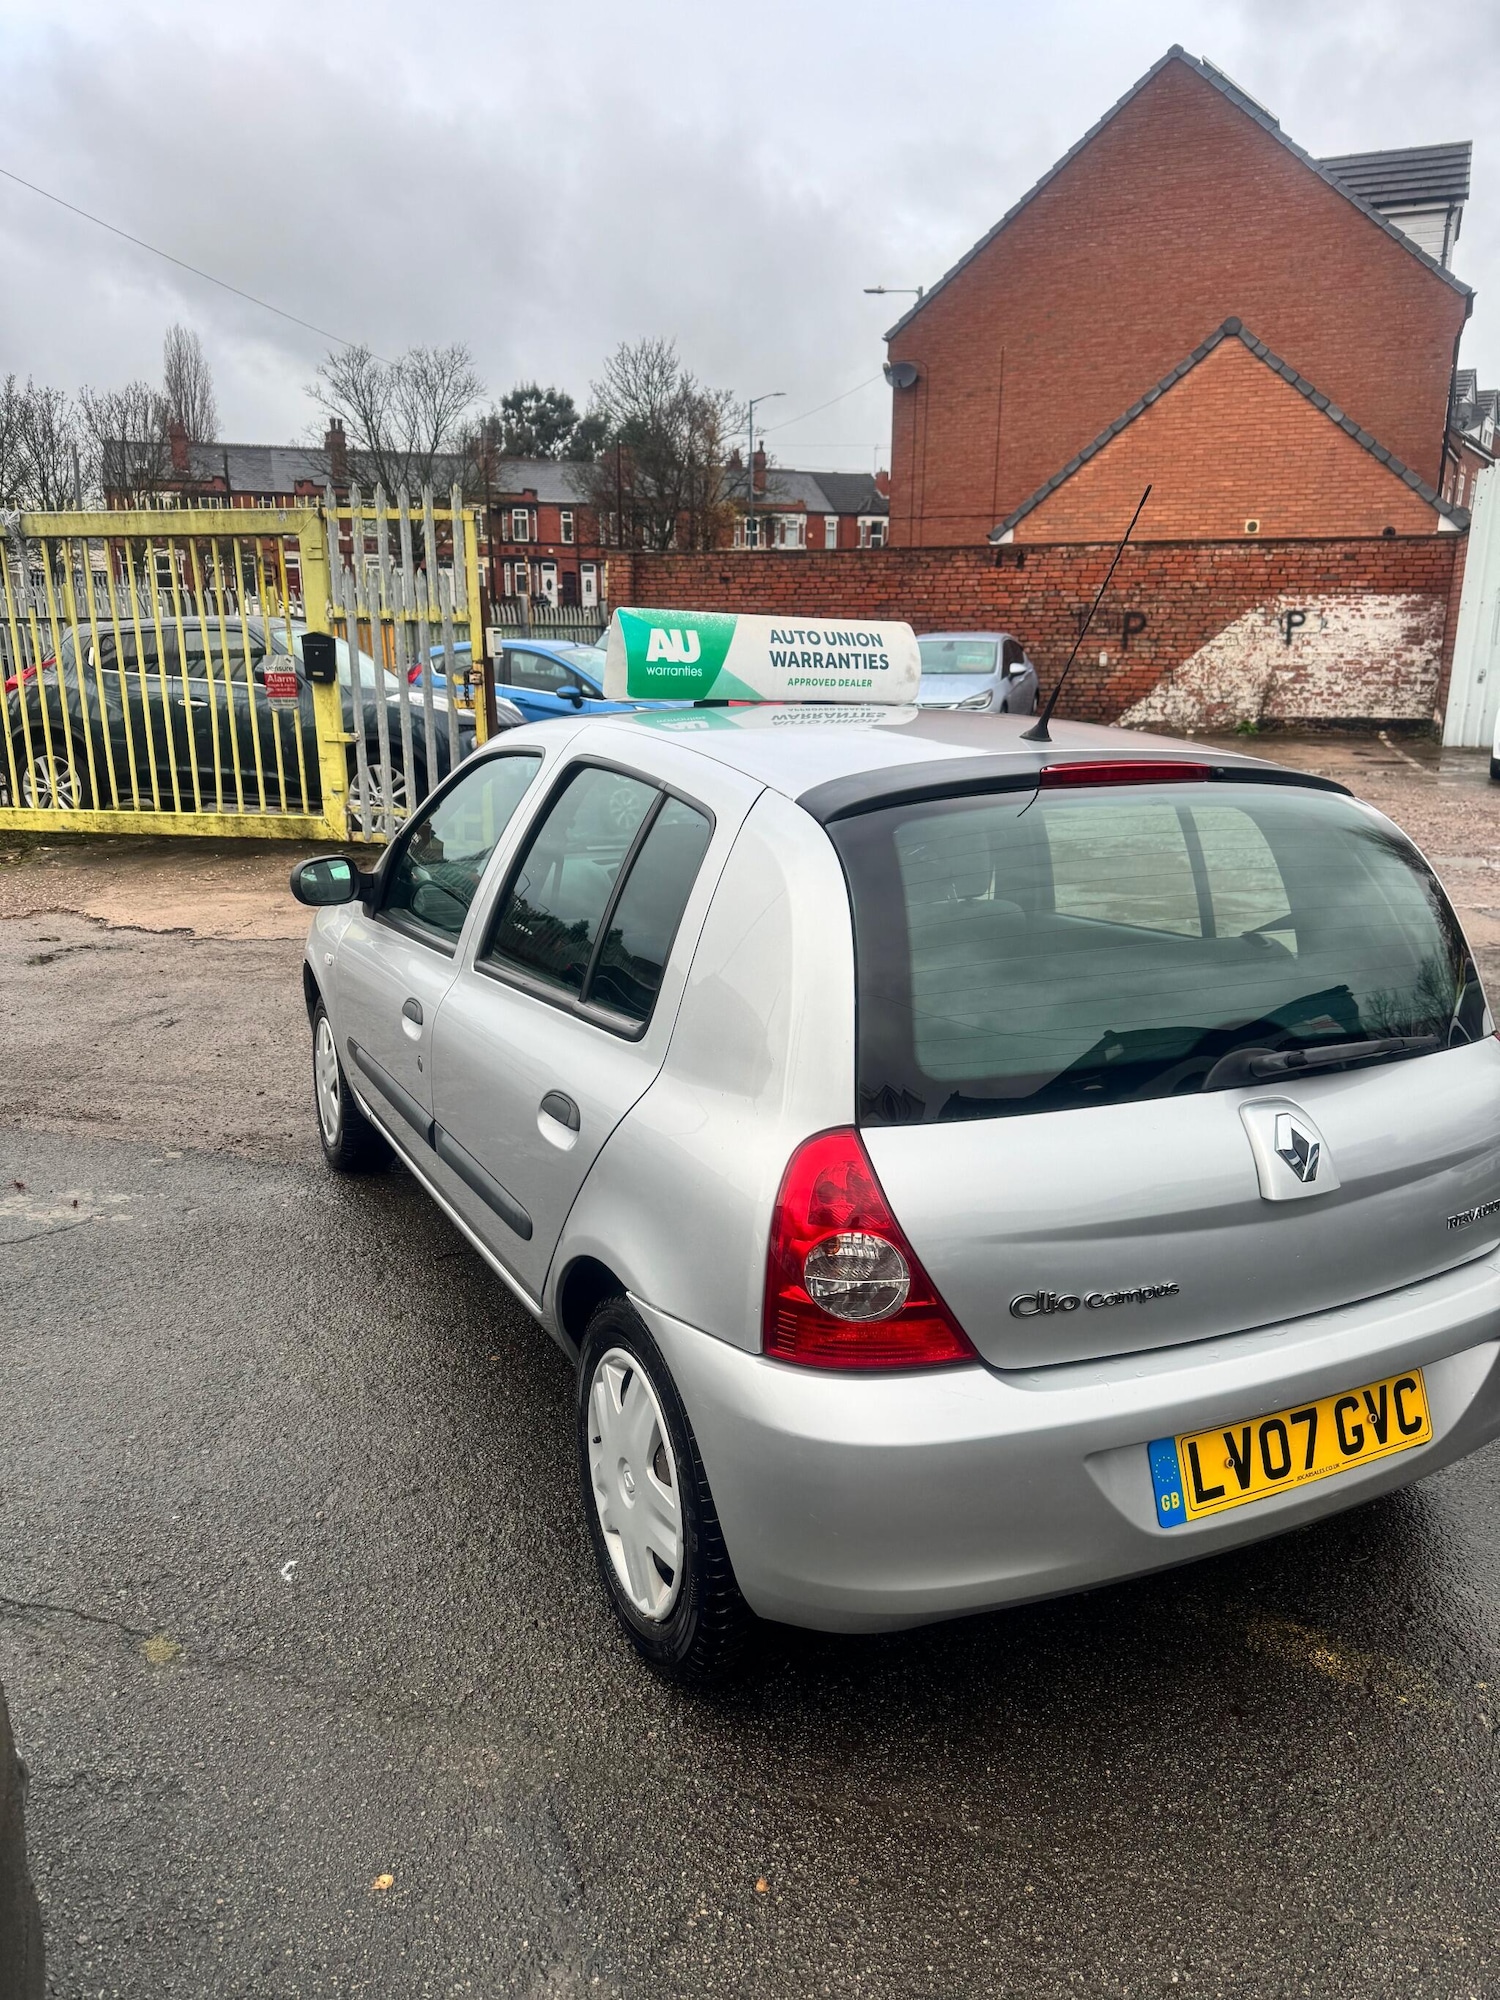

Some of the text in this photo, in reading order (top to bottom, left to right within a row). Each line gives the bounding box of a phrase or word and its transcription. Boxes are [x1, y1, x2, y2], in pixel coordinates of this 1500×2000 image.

[1285, 610, 1306, 646] P
[646, 628, 700, 663] AU
[769, 629, 884, 648] AUTO UNION
[769, 650, 890, 670] WARRANTIES
[267, 674, 295, 683] Alarm
[646, 664, 703, 678] warranties
[787, 677, 873, 688] APPROVED DEALER
[1010, 1281, 1180, 1319] Clio Campus
[1188, 1377, 1423, 1503] LV07 GVC
[1160, 1492, 1180, 1511] GB
